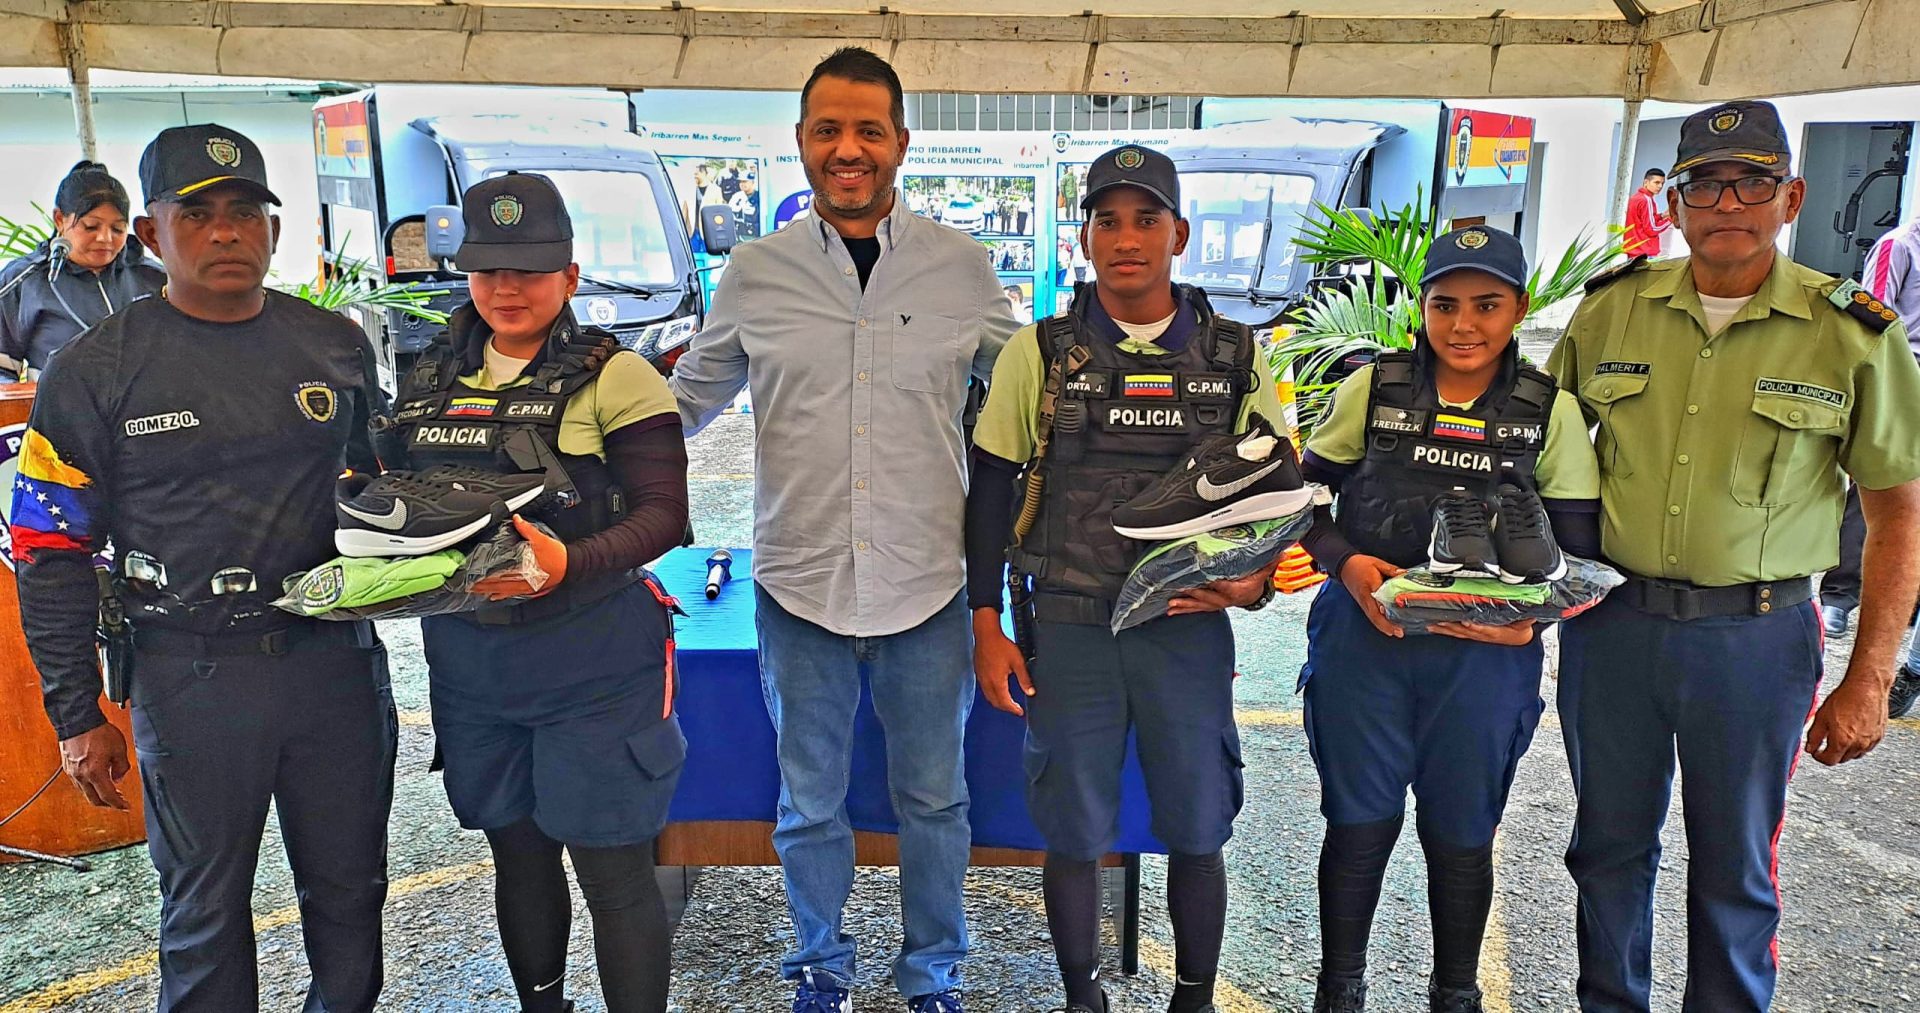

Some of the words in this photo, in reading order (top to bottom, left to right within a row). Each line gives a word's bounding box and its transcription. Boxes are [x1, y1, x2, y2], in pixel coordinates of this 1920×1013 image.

[650, 131, 690, 140] Iribarren
[692, 133, 710, 141] Mas
[712, 133, 742, 143] Seguro
[928, 146, 982, 154] IRIBARREN
[908, 156, 948, 164] POLICIA
[950, 156, 1004, 165] MUNICIPAL
[1596, 363, 1636, 373] PALMERI
[1760, 381, 1794, 393] POLICIA
[1797, 385, 1842, 404] MUNICIPAL
[507, 405, 554, 416] C.P.M.I
[1109, 408, 1184, 426] POLICIA
[125, 412, 181, 436] GOMEZ
[415, 426, 488, 445] POLICIA
[1413, 445, 1492, 472] POLICIA
